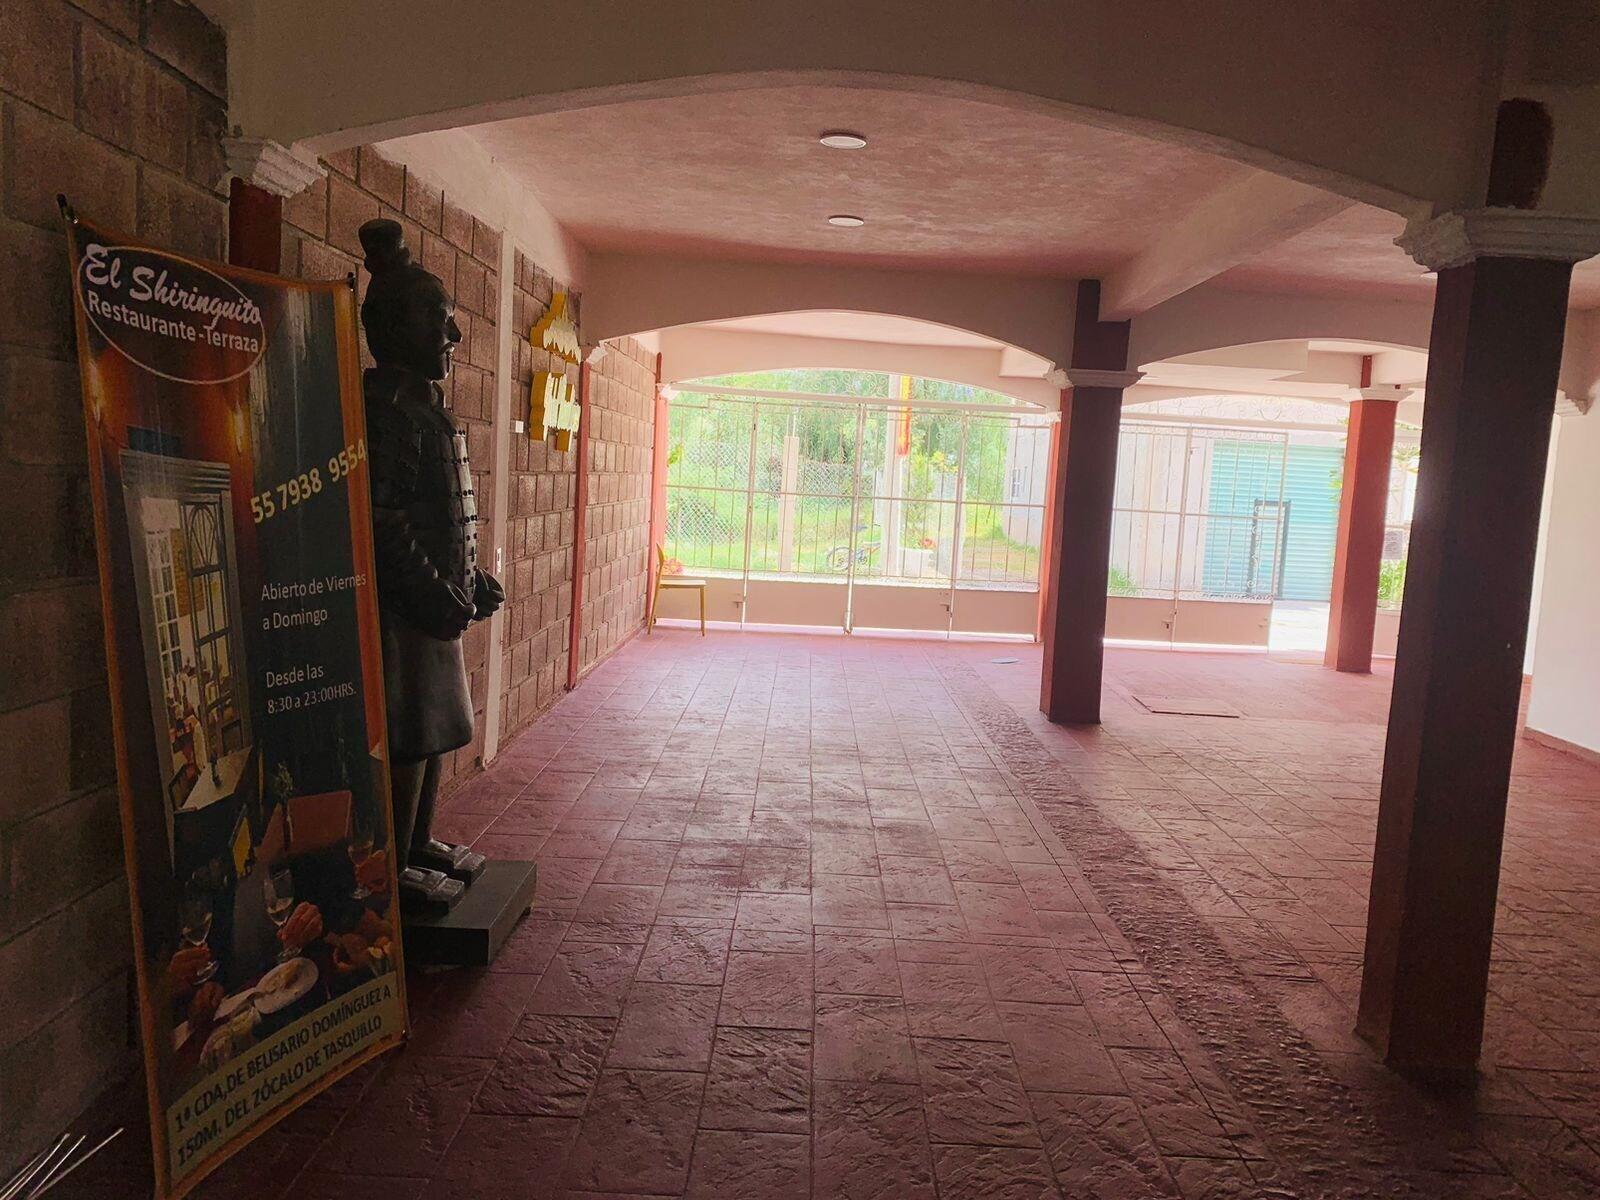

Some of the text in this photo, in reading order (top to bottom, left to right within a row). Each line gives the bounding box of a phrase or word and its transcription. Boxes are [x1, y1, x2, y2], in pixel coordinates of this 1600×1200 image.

[86, 243, 122, 289] El
[250, 438, 367, 524] 55 7938 9554
[262, 573, 367, 601] Abierto de Viernes
[263, 608, 328, 631] a Domingo
[266, 664, 324, 688] Desde las
[267, 696, 293, 714] 8:30
[294, 697, 301, 708] a
[247, 1028, 309, 1079] BELISARIO
[312, 988, 382, 1038] DOMÍNGUEZ
[383, 985, 391, 1000] A
[225, 1099, 250, 1127] DEL
[252, 1062, 304, 1108] ZÓCALO
[305, 1050, 321, 1074] DE
[322, 1015, 382, 1060] TASQUILLO
